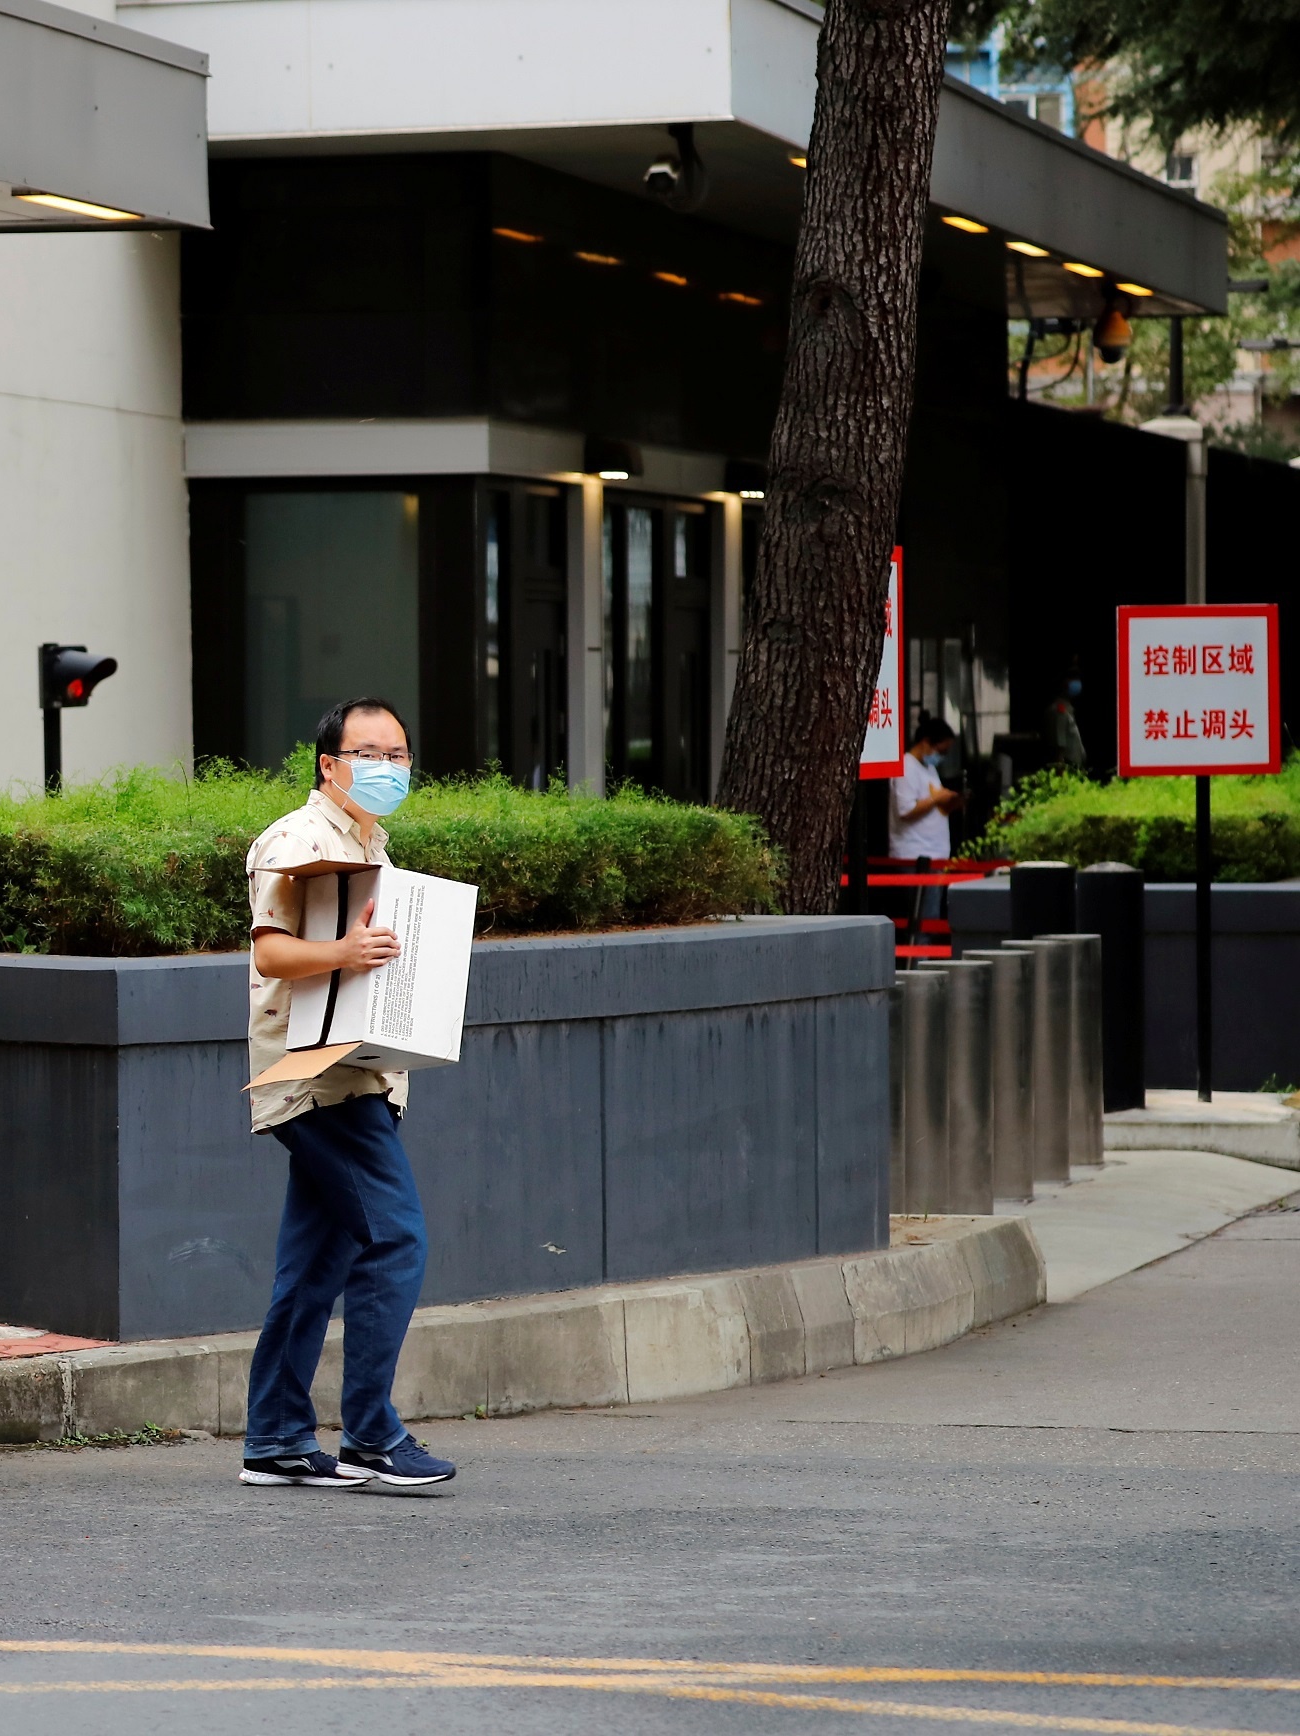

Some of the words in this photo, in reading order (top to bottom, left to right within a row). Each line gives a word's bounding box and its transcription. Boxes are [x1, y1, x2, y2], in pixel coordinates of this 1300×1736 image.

[1143, 643, 1255, 676] 控制区域
[1144, 708, 1255, 740] 禁止调头
[369, 994, 379, 1035] INSTRUCTIONS
